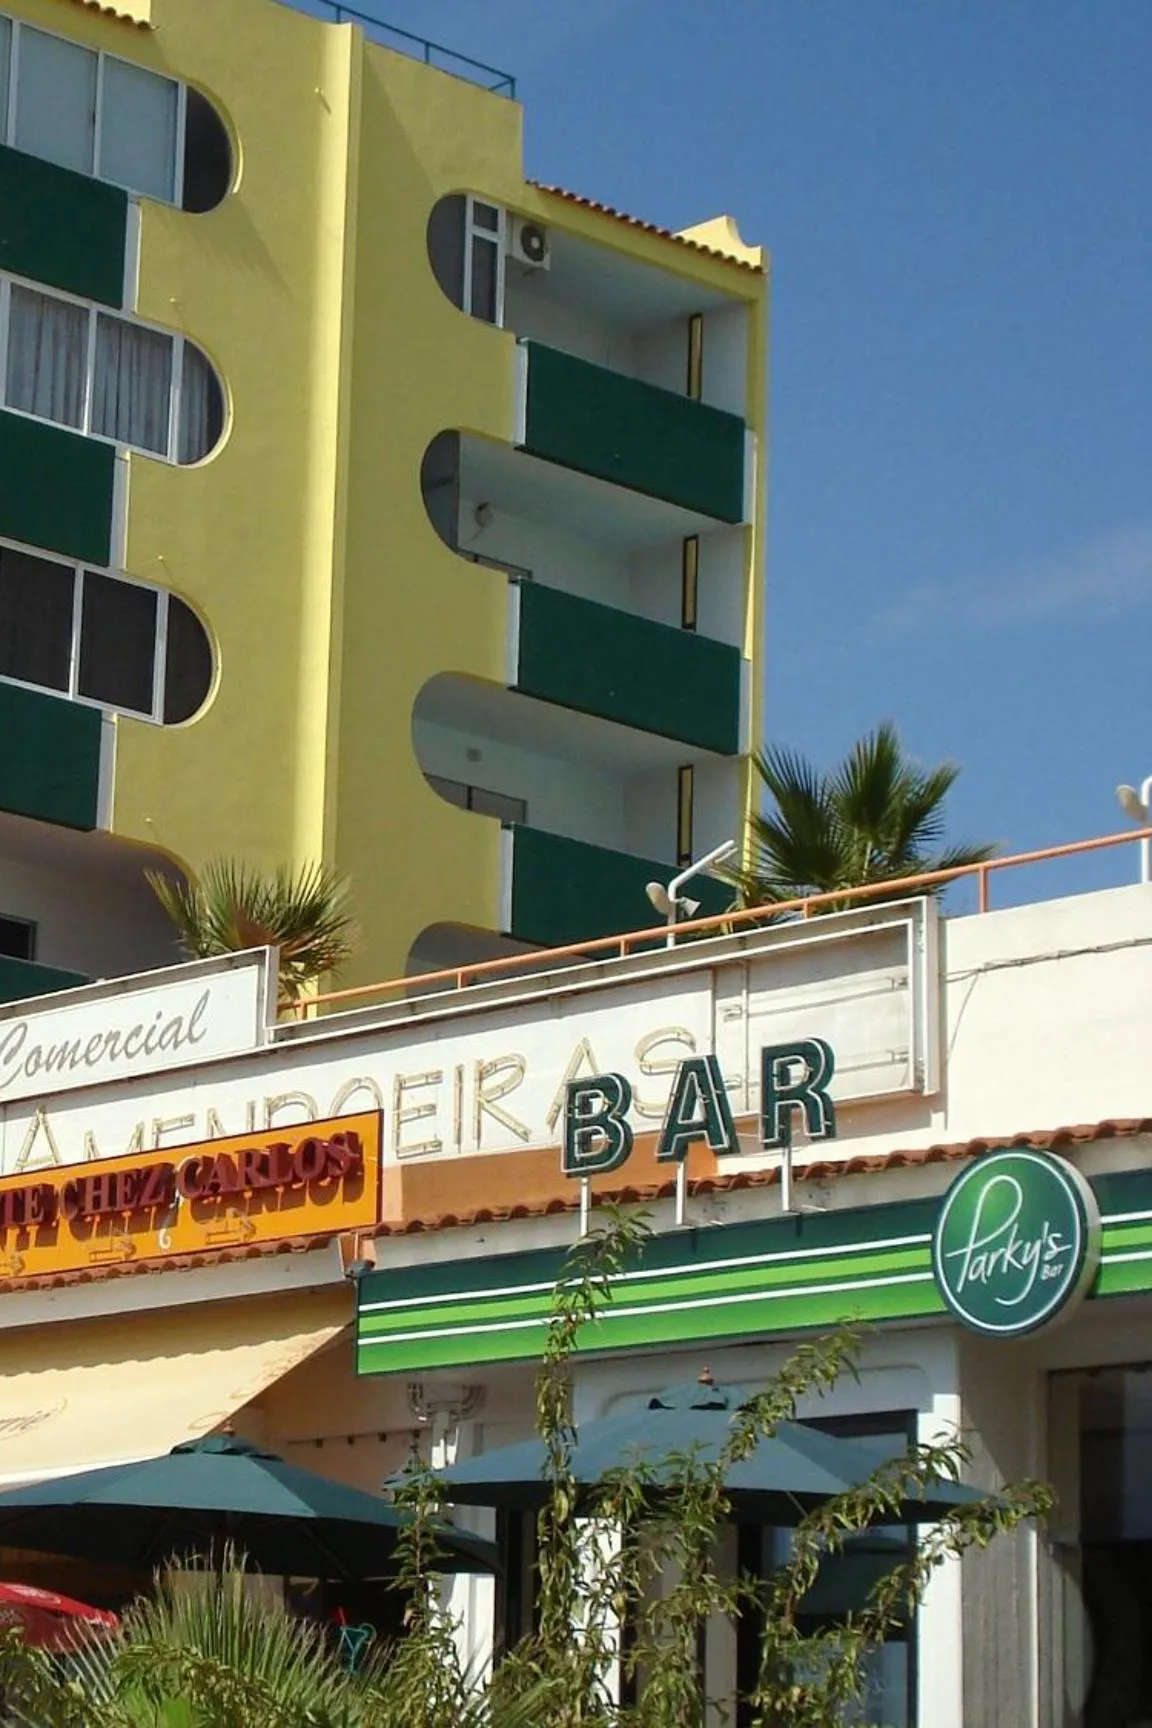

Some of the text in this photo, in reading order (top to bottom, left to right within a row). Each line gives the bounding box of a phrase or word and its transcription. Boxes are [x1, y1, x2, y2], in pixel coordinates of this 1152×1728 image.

[561, 1037, 836, 1178] BAR
[59, 1163, 174, 1221] CHEZ
[176, 1131, 362, 1200] CARLOS
[945, 1174, 1073, 1305] Parky's
